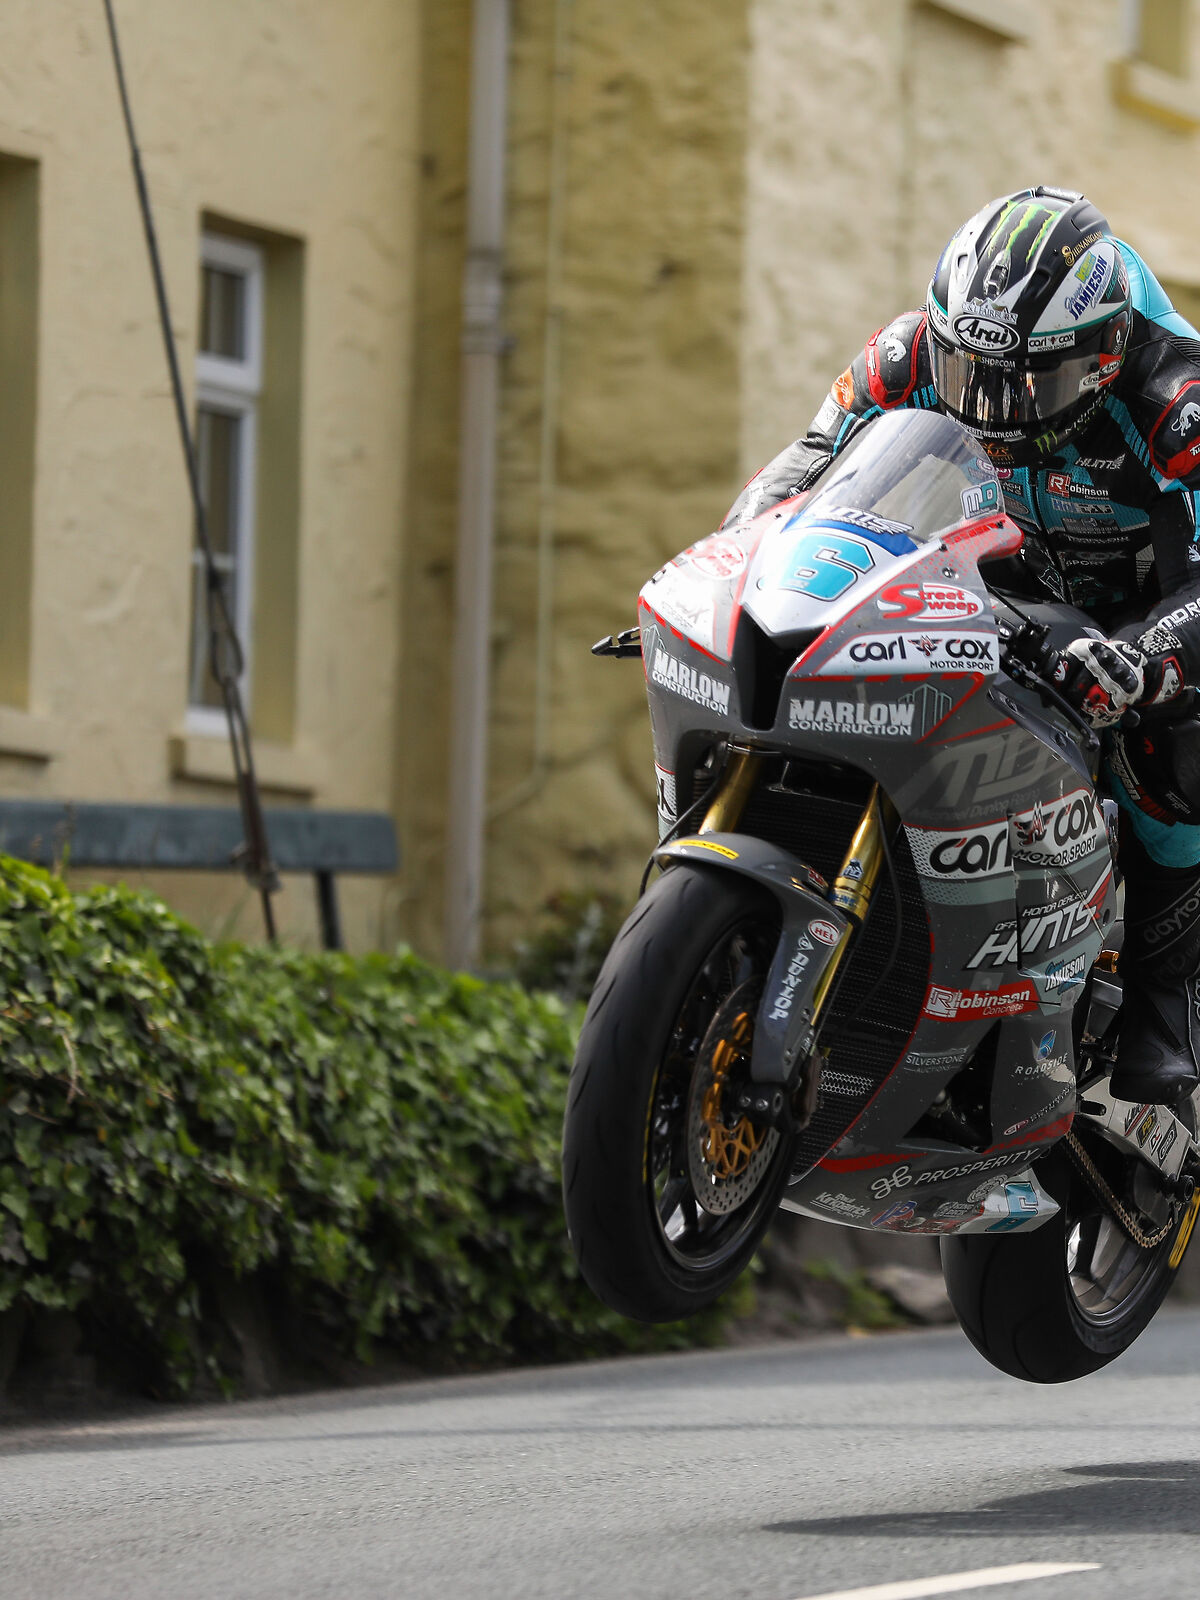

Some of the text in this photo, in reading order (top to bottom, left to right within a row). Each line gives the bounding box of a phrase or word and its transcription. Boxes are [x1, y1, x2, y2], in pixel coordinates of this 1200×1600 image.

[1069, 255, 1108, 320] JAMIESON
[957, 319, 1009, 345] Arai
[1028, 333, 1074, 347] carl cox
[849, 635, 994, 663] carl cox
[653, 648, 731, 704] MARLOW
[929, 661, 994, 671] MOTOR SPORT
[652, 672, 729, 716] CONSTRUCTION
[788, 698, 915, 726] MARLOW
[788, 719, 913, 736] CONSTRUCTION
[1053, 795, 1098, 847] cox
[1014, 835, 1097, 867] MOTOR SPORT
[814, 927, 835, 942] HEL
[769, 951, 810, 1021] DUNLOP
[1045, 954, 1086, 992] JAMIESON
[906, 1054, 965, 1067] SILVERSTONE
[1014, 1052, 1069, 1075] ROADSIDE
[914, 1148, 1040, 1186] PROSPERITY
